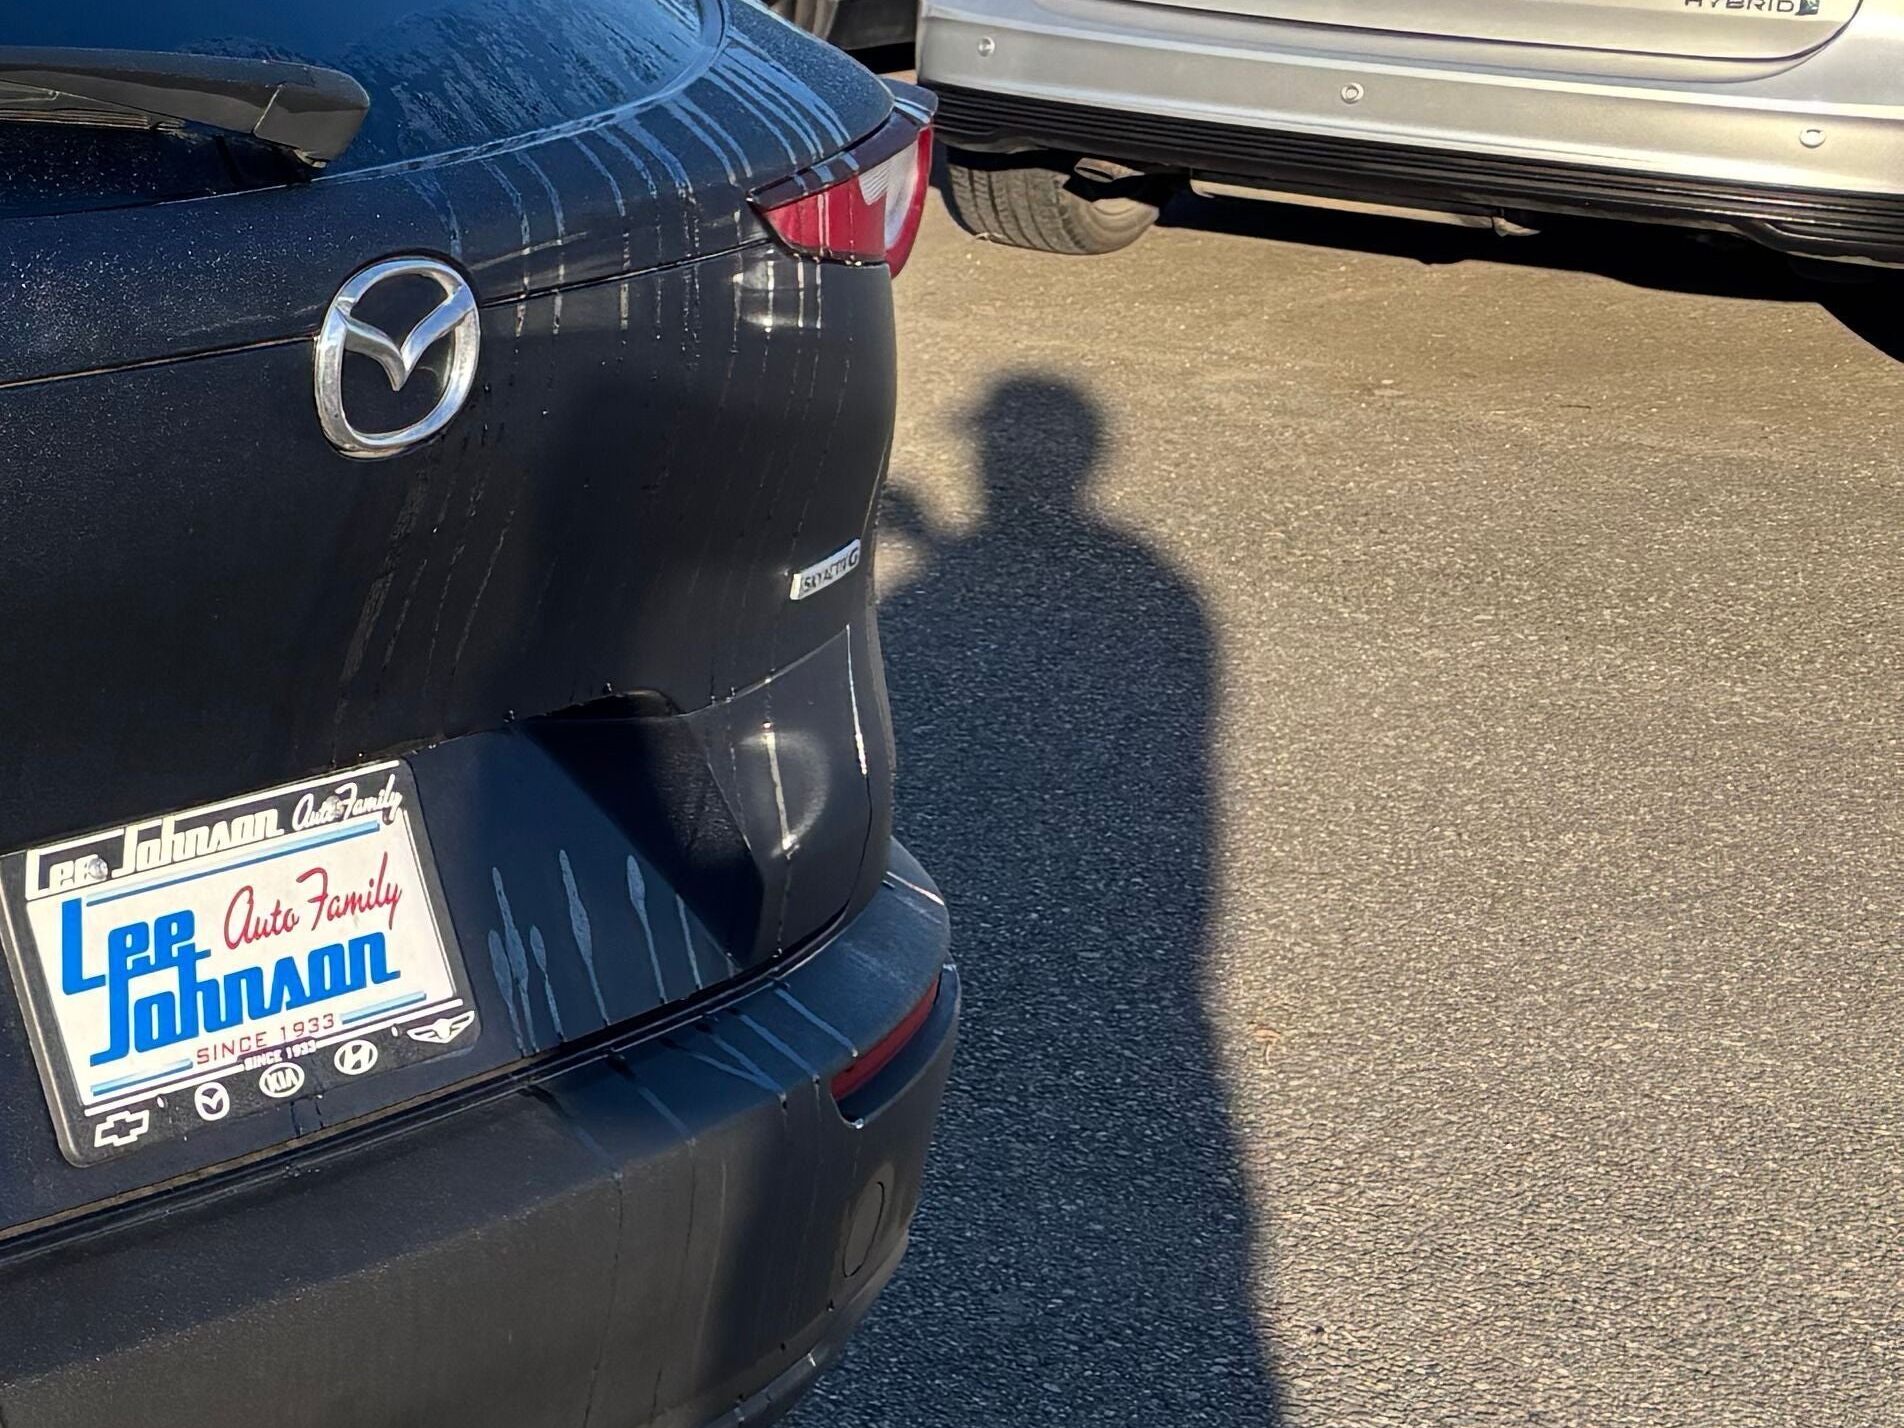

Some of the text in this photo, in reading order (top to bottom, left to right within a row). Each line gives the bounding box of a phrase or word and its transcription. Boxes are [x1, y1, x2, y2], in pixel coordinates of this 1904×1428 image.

[24, 849, 104, 902] Lee
[111, 808, 284, 879] Johnson
[330, 774, 405, 824] Family
[61, 851, 403, 996] Lee Auto Family
[90, 931, 401, 1067] Johnson
[195, 1012, 335, 1065] SINCE 1933
[265, 1066, 301, 1093] KIA
